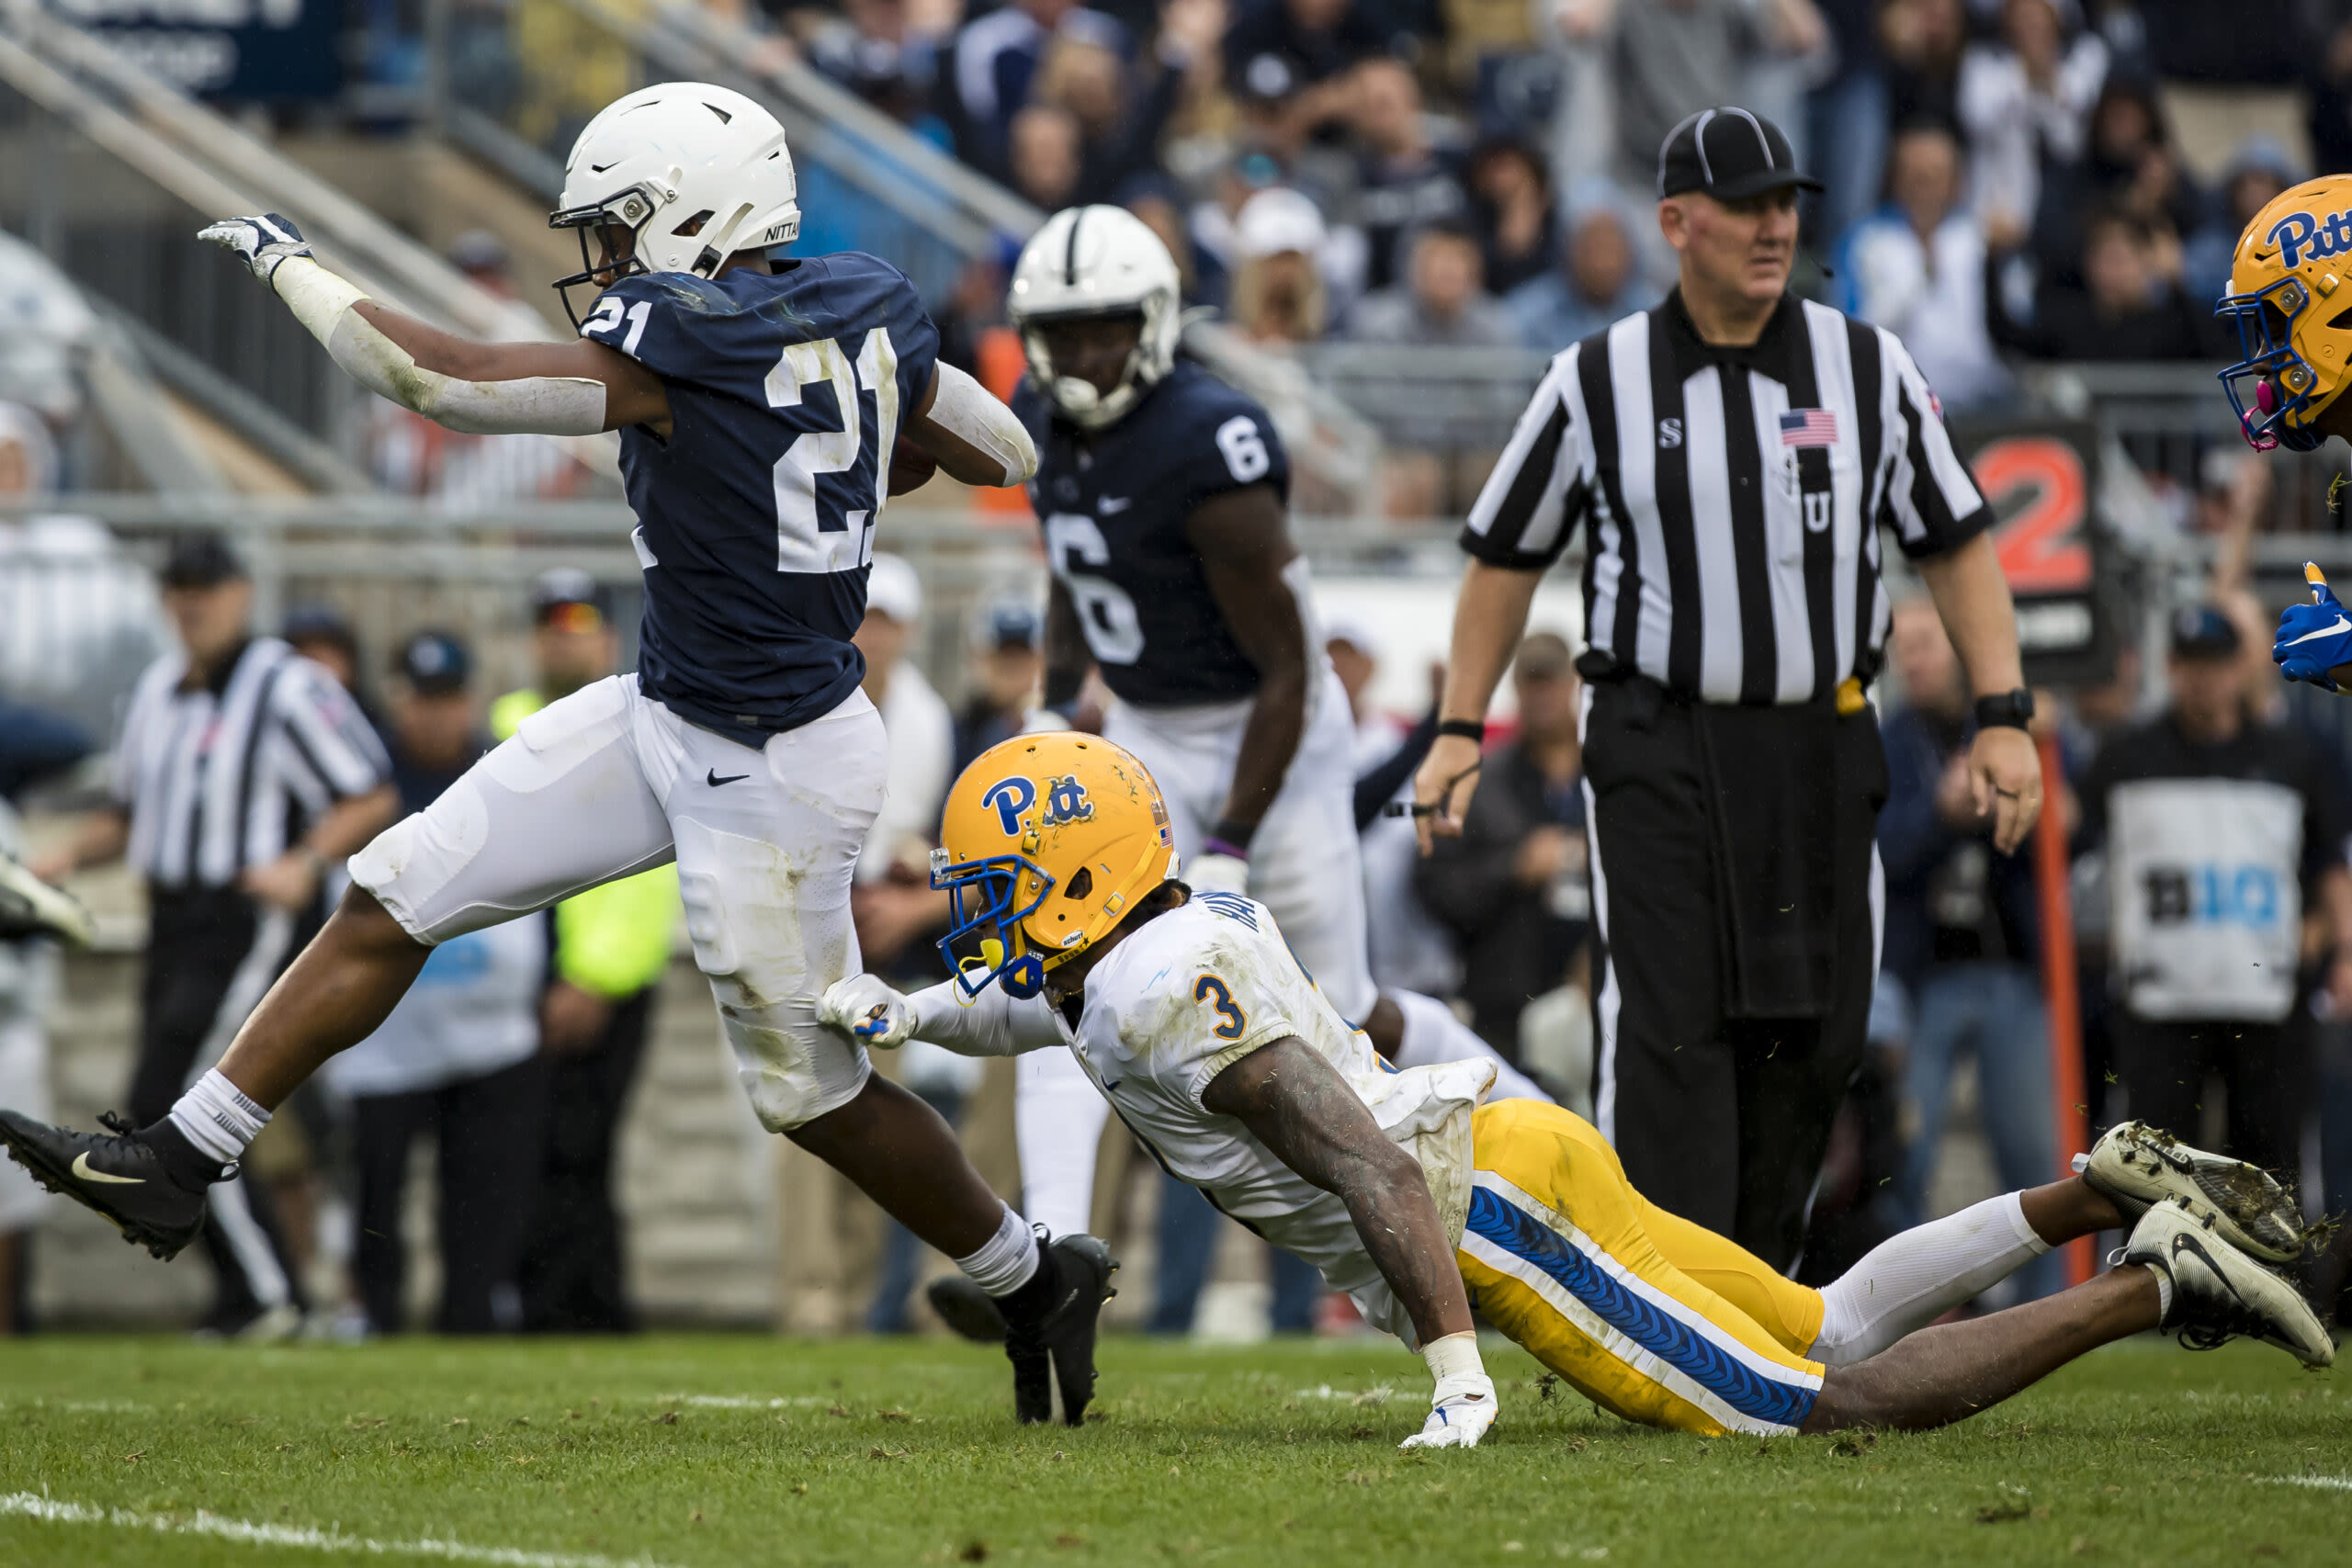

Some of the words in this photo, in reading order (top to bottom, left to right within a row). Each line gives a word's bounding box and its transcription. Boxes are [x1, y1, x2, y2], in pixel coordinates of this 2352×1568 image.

[764, 221, 800, 243] NITTA
[2265, 209, 2352, 270] Pit
[581, 296, 653, 362] 21
[764, 327, 899, 574] 21
[1216, 415, 1271, 483] 6
[1658, 417, 1683, 449] S
[1804, 491, 1832, 533] U
[1973, 435, 2092, 592] 2
[1046, 513, 1146, 666] 6
[1193, 974, 1248, 1041] 3
